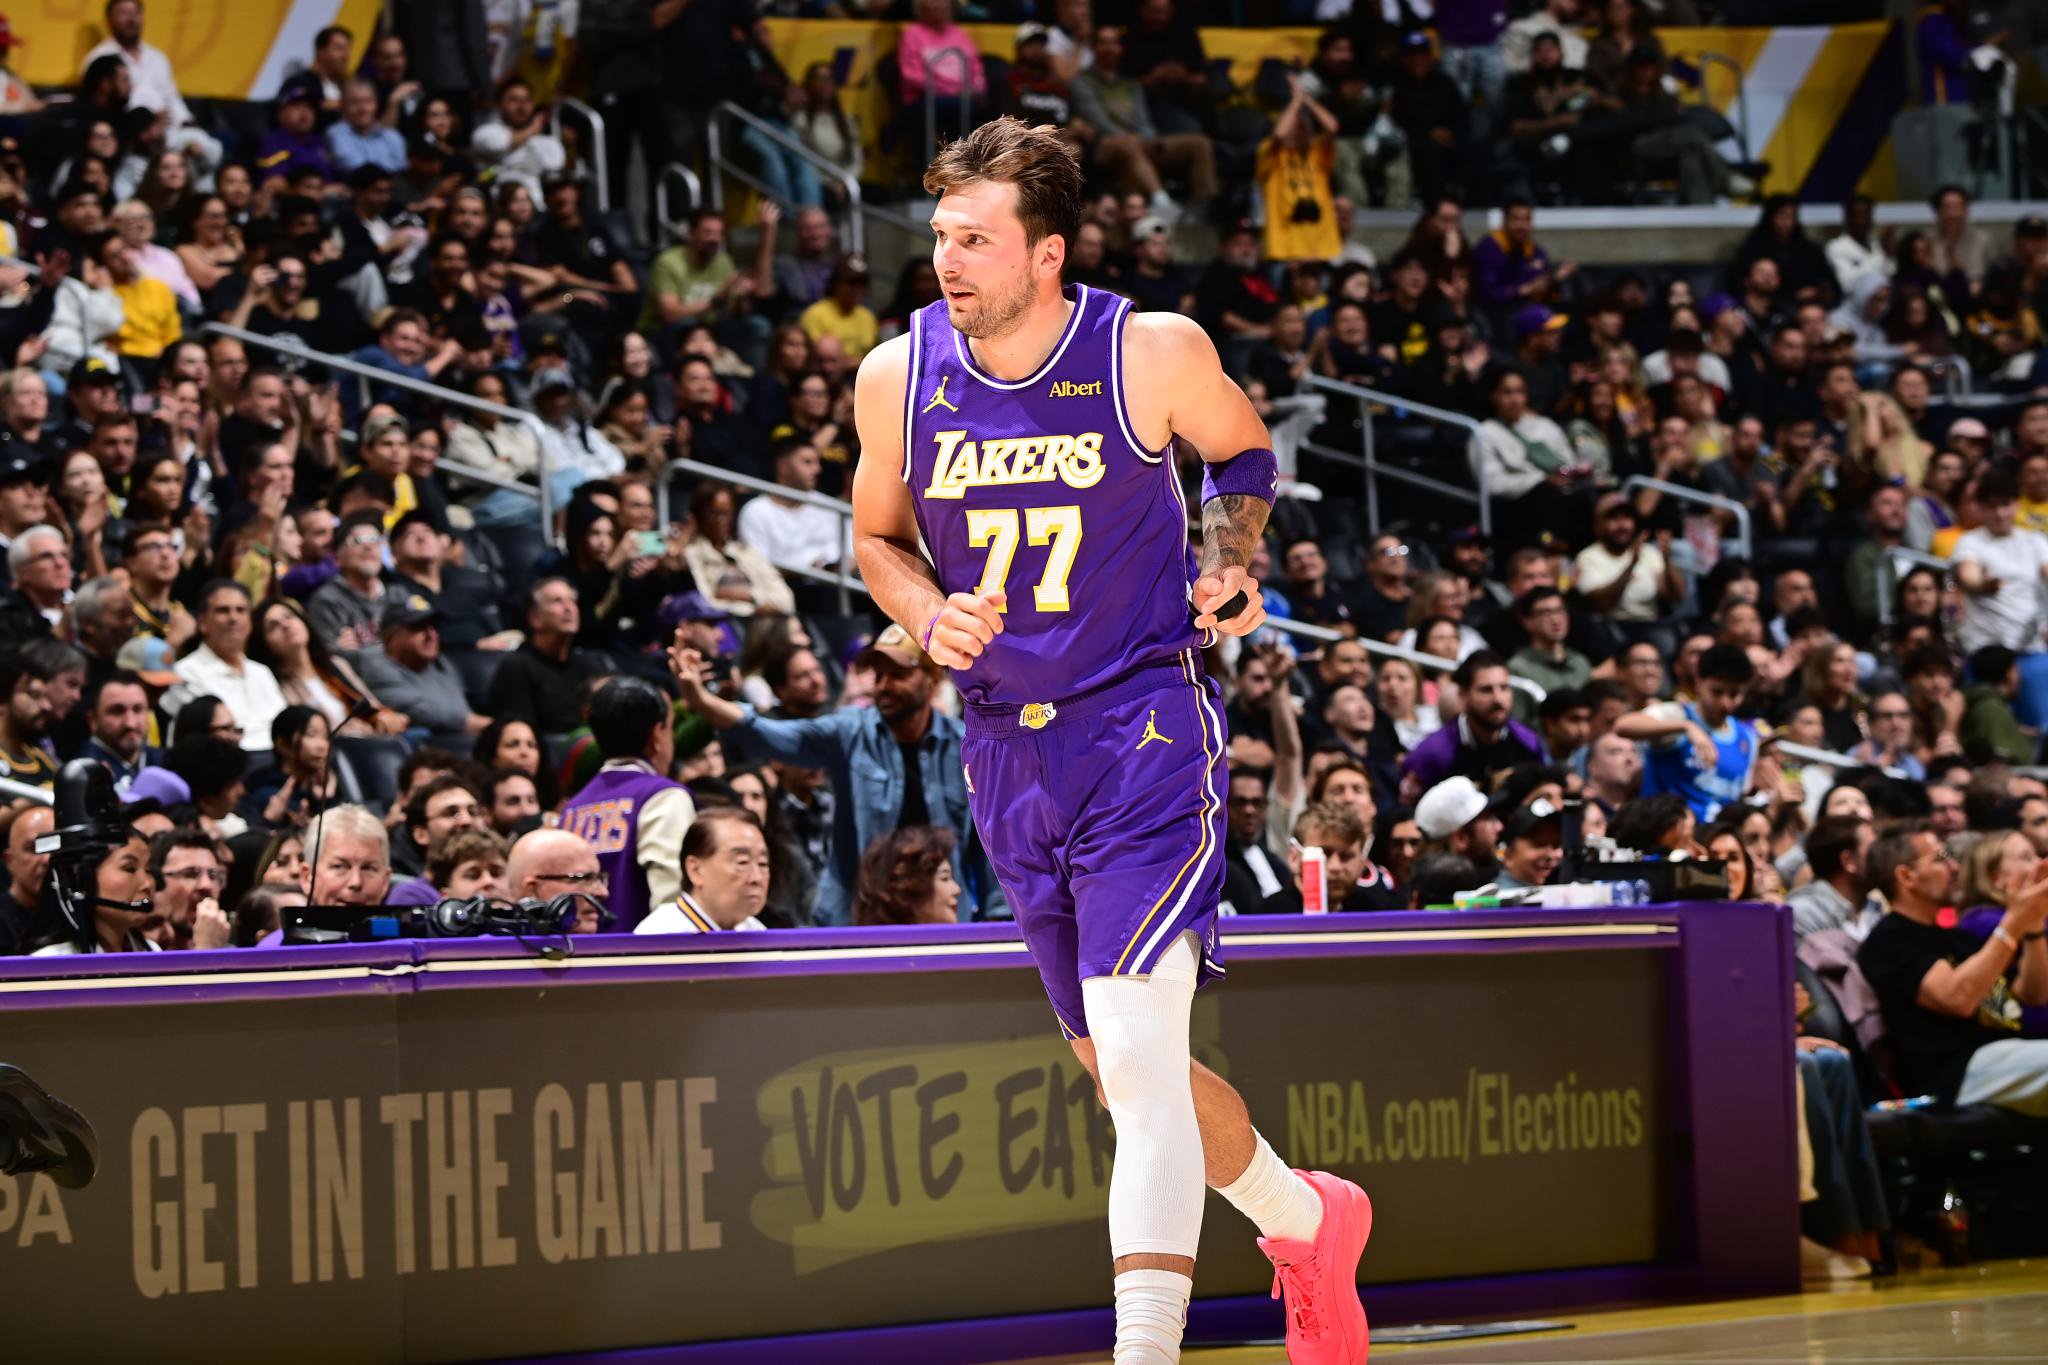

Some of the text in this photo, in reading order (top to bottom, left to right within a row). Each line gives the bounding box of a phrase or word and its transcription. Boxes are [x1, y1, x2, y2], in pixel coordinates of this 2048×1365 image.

[1049, 381, 1102, 397] Albert
[924, 430, 1106, 499] LAKERS
[965, 505, 1083, 612] 77
[792, 1065, 967, 1220] VOTE
[1286, 1067, 1643, 1167] NBA.com/Elections
[131, 1077, 722, 1298] GET IN THE GAME
